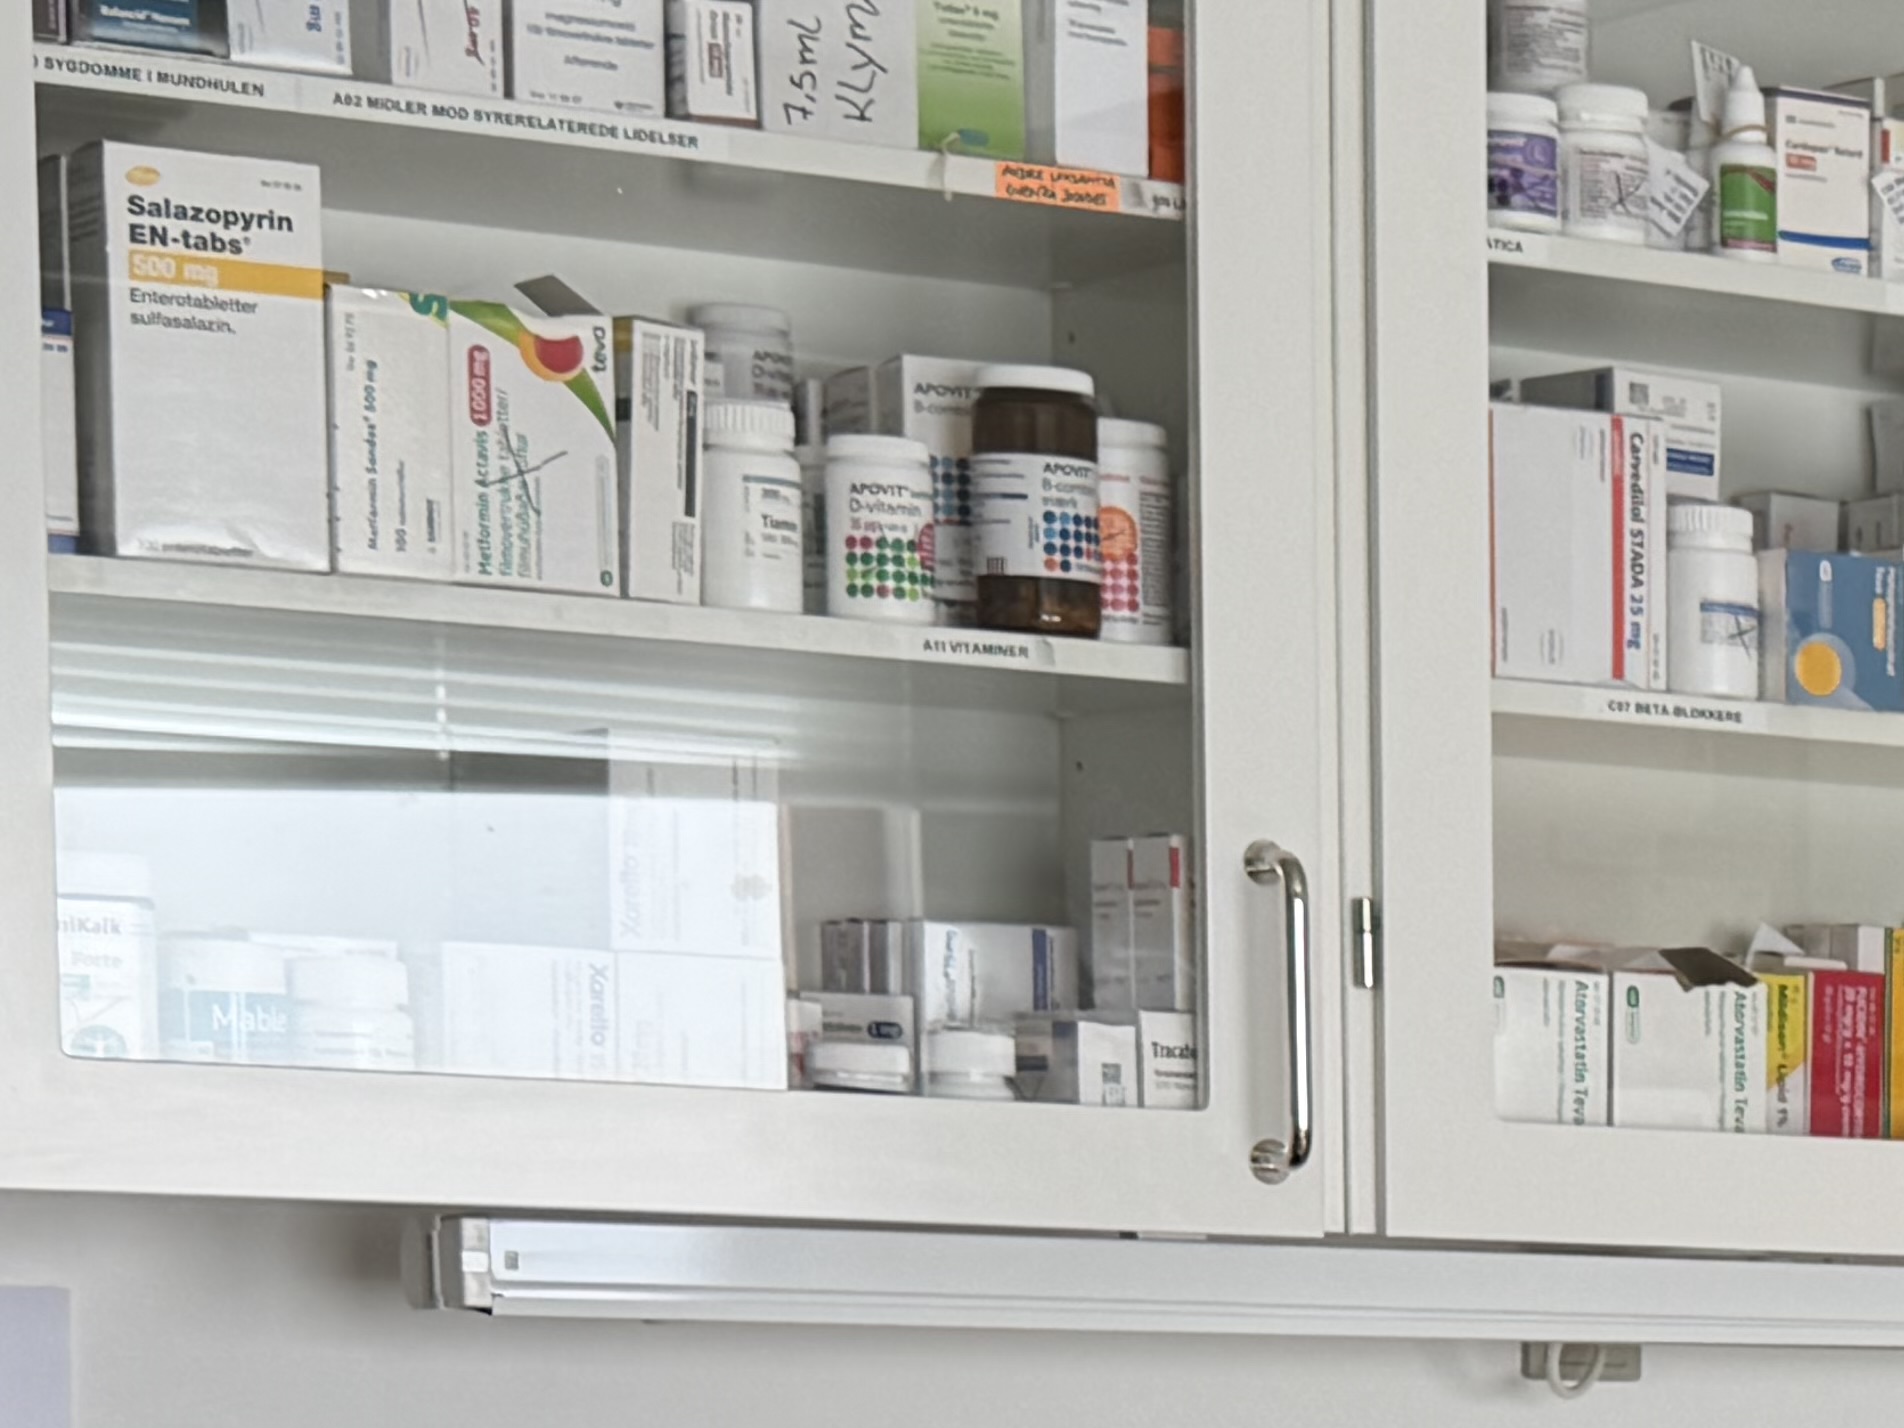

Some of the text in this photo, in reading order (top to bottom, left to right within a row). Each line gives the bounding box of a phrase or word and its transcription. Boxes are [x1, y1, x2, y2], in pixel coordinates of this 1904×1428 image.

[44, 56, 141, 83] SYGDOMME
[157, 71, 265, 97] MUNDHULEN
[433, 105, 470, 121] MOD
[626, 127, 702, 151] LIDELSER
[127, 194, 294, 232] Salazopyrin
[131, 252, 219, 287] 500 mg
[129, 289, 257, 315] Enterotabletter
[850, 500, 921, 518] D-vitamin
[474, 493, 492, 576] Metformin
[1626, 431, 1645, 651] Carvedilol STADA 25 mg
[950, 640, 1029, 658] VITAMINER
[1573, 980, 1590, 1126] Atorvastatin Teva
[1733, 990, 1750, 1092] Atorvastatin
